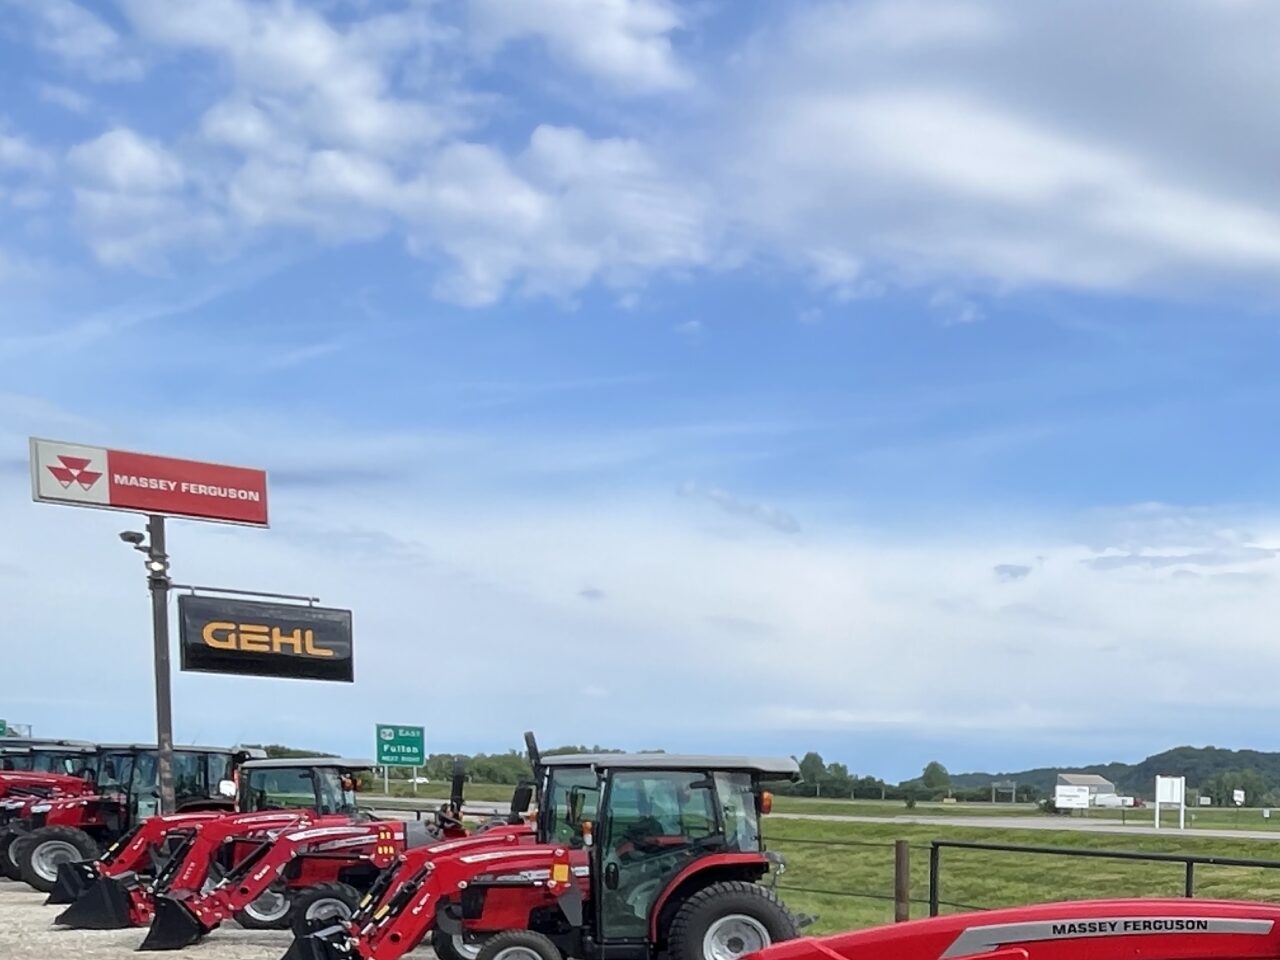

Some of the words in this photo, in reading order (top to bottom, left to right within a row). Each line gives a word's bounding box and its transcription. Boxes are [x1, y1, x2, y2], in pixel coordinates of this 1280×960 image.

[114, 474, 177, 491] MASSEY
[181, 482, 260, 501] FERGUSON
[203, 621, 334, 657] GEHL
[383, 744, 419, 753] Fulton
[1052, 922, 1118, 935] MASSEY
[1123, 920, 1208, 931] FERGUSON
